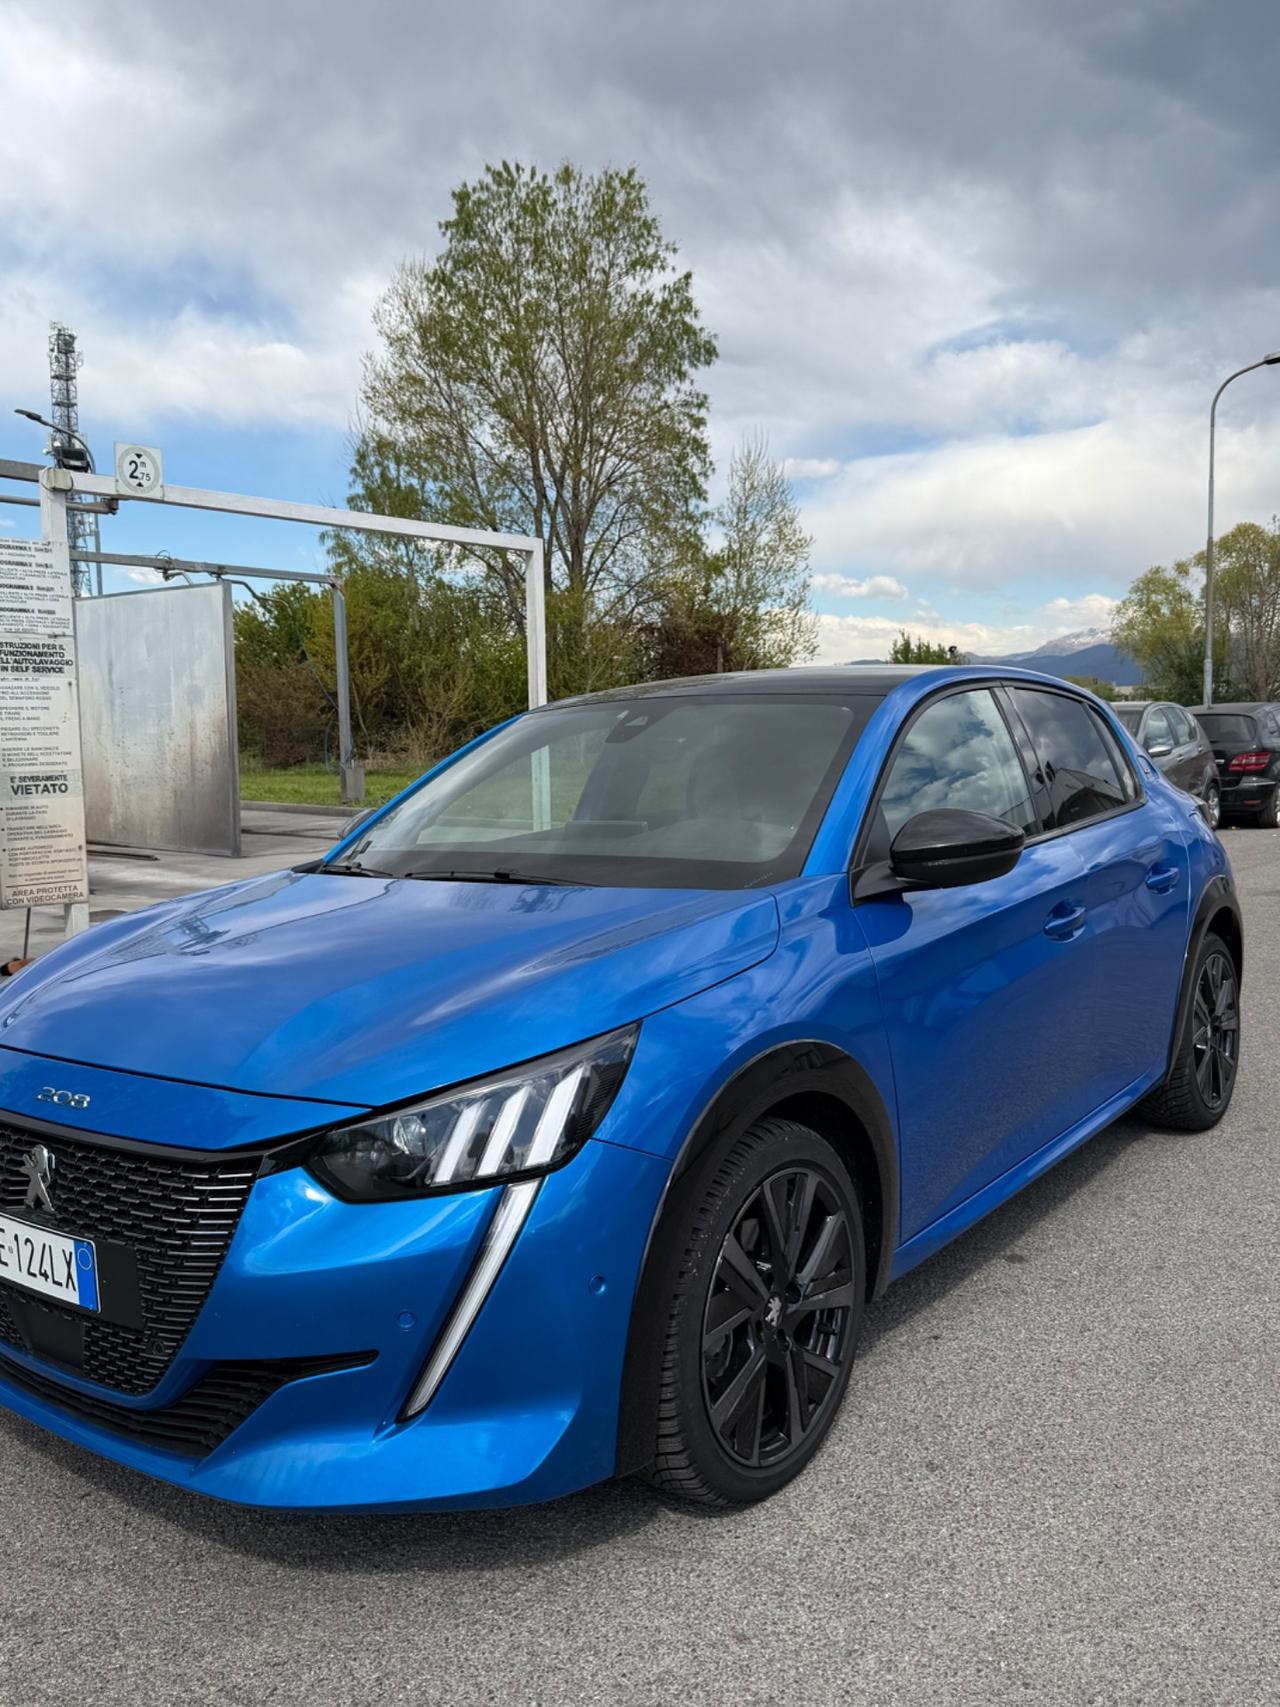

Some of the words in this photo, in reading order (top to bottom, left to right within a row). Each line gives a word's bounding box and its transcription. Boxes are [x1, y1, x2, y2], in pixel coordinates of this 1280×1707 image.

[11, 665, 30, 673] SELF
[31, 666, 65, 674] SERVICE
[18, 774, 68, 783] SEVERAMENTE
[11, 783, 68, 796] VIETATO
[7, 897, 25, 905] CON
[26, 891, 84, 903] VIDEOCAMERA
[12, 889, 35, 898] AREA
[36, 885, 79, 895] PROTETTA
[36, 1086, 91, 1109] 208
